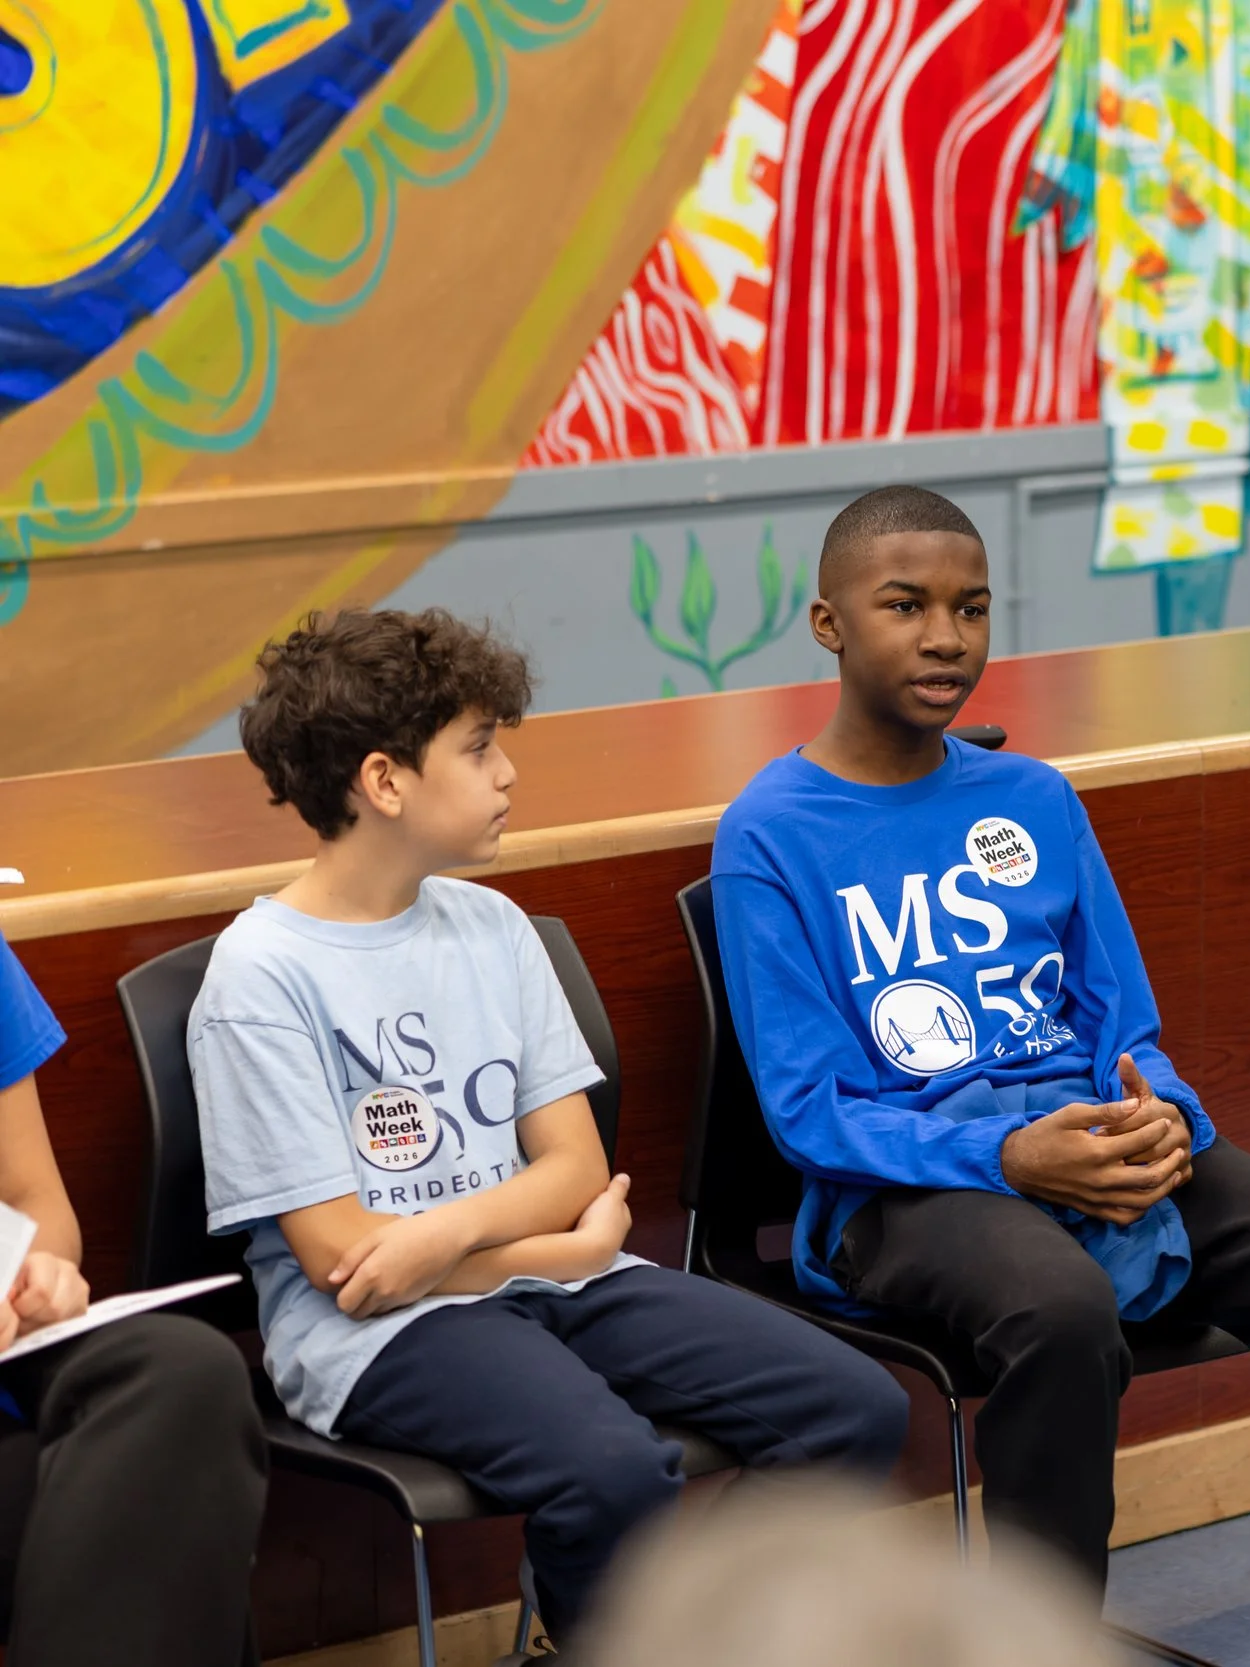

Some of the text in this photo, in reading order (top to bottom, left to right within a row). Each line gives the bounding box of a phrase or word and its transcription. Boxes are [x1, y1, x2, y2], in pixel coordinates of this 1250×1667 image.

[973, 827, 1016, 851] Math
[979, 841, 1026, 864] Week
[1004, 870, 1030, 882] 2026
[836, 864, 1008, 985] MS
[976, 952, 1064, 1020] 50
[333, 1011, 436, 1093] MS
[364, 1100, 418, 1121] Math
[366, 1117, 424, 1138] Week
[384, 1152, 418, 1163] 2026
[368, 1174, 466, 1208] PRIDE
